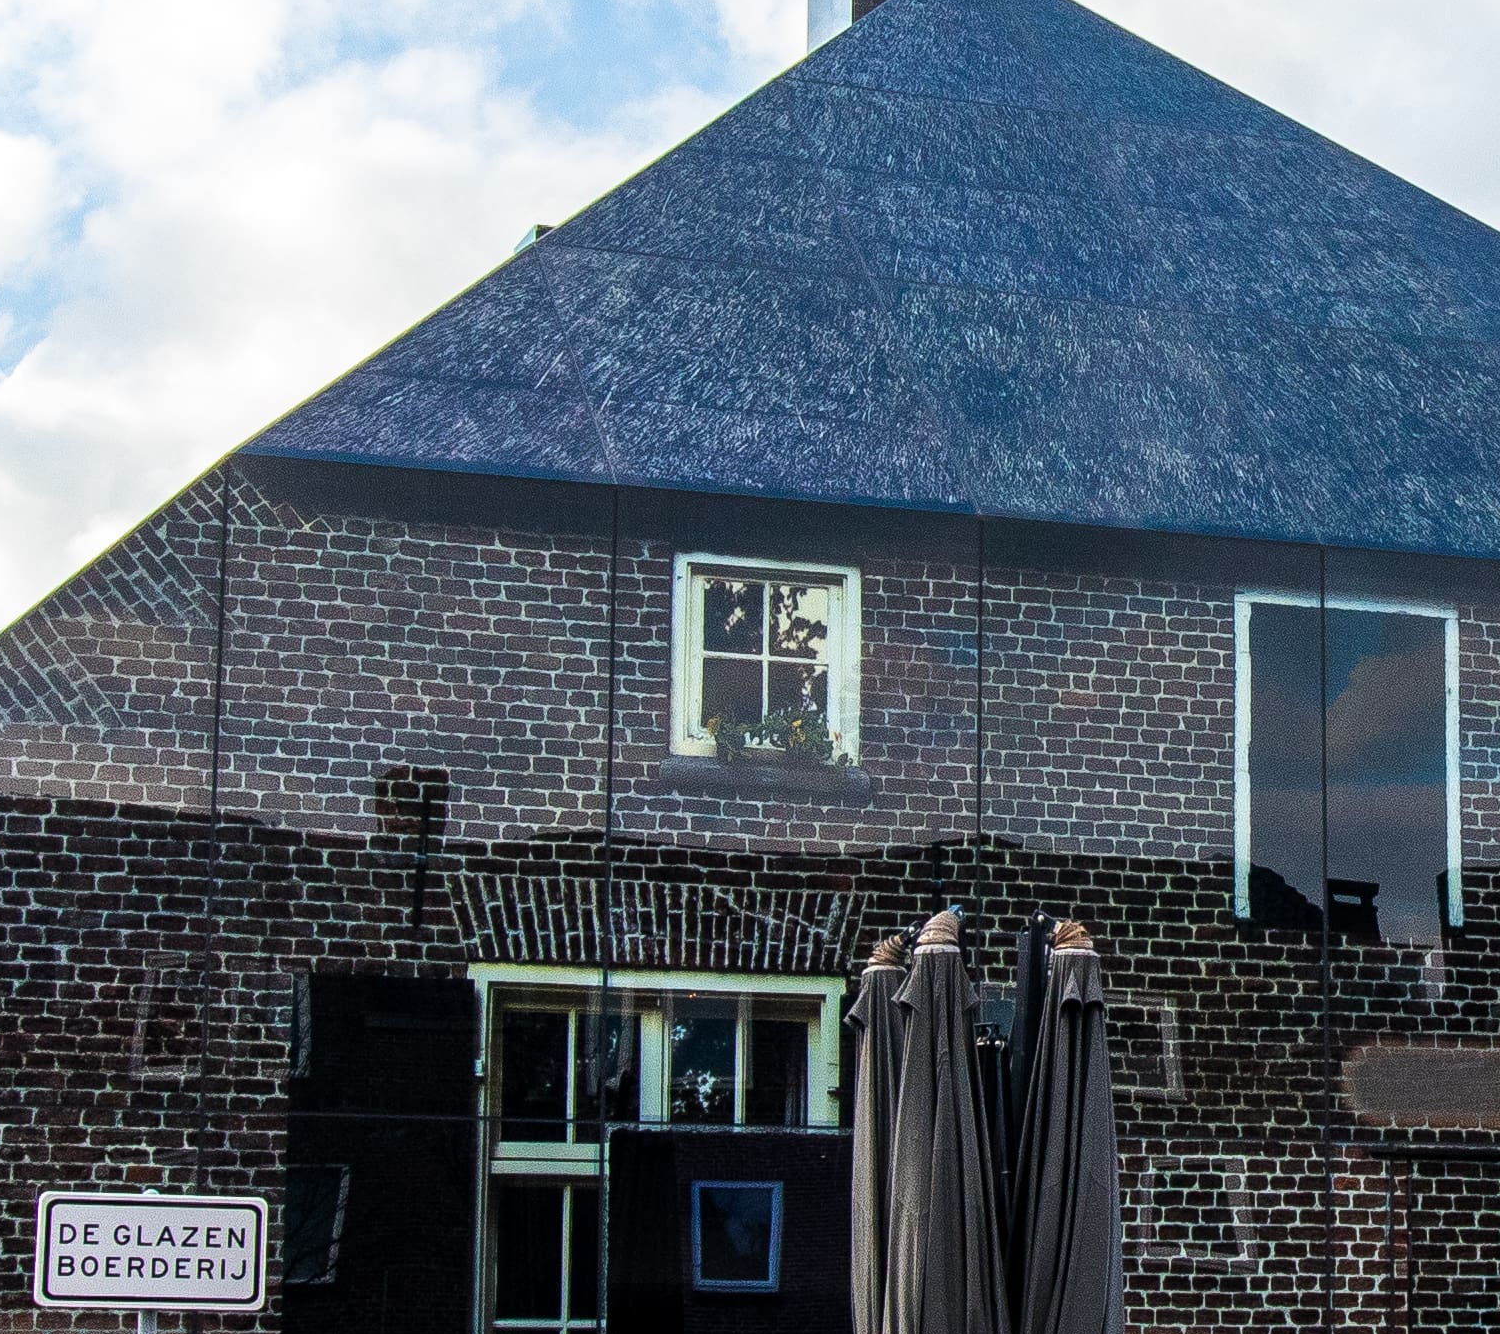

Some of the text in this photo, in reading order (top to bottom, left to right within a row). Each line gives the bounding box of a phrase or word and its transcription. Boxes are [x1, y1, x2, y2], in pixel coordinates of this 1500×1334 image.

[59, 1223, 247, 1249] DE GLAZEN
[57, 1255, 248, 1281] BOERDERIJ
